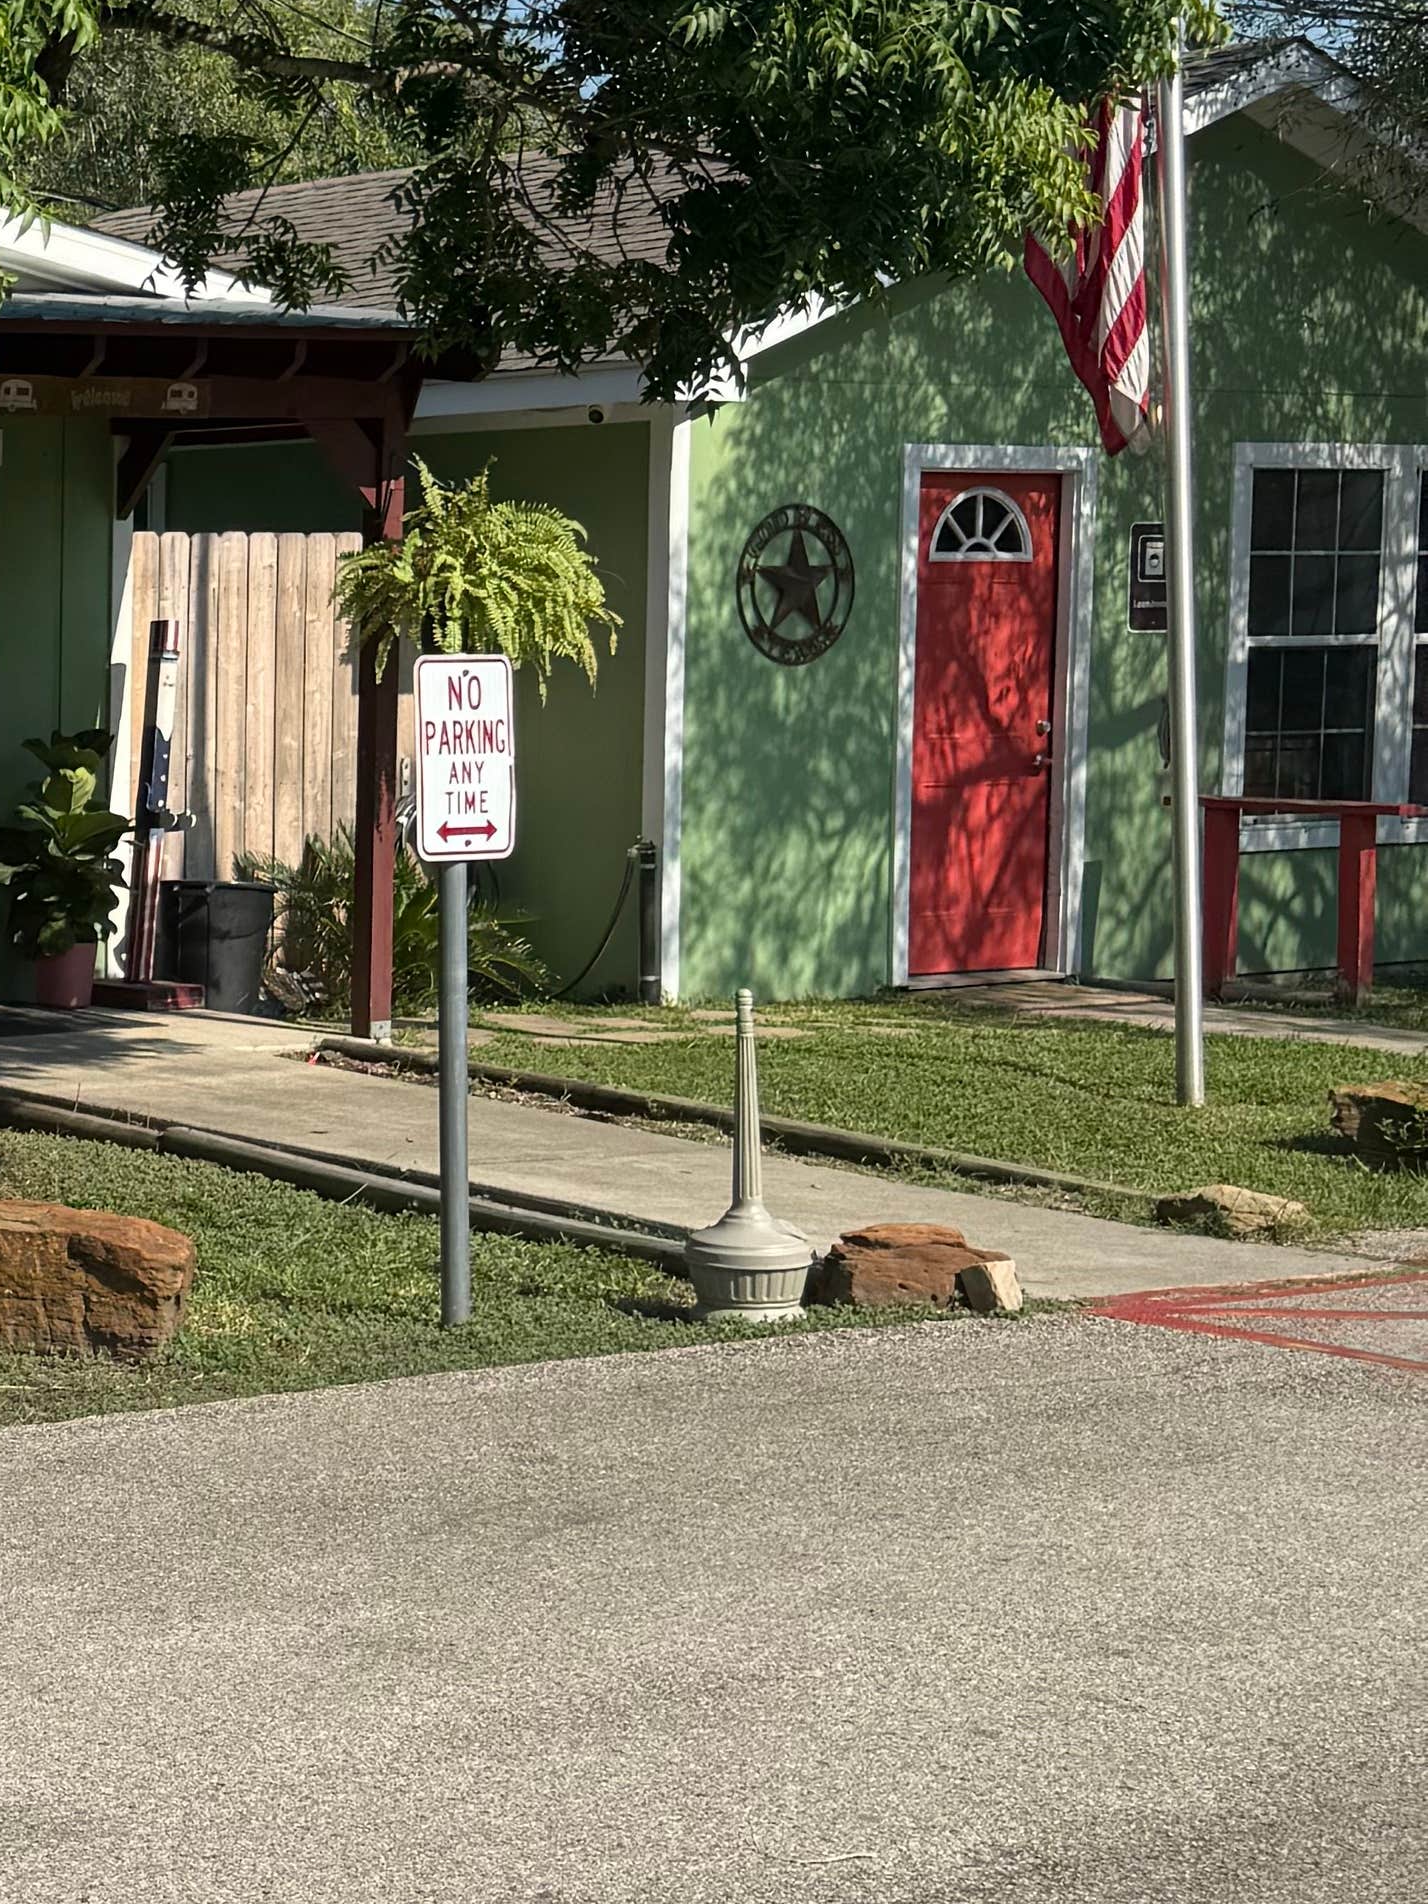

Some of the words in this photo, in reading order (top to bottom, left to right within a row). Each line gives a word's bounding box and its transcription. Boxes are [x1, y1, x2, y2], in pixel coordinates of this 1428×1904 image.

[447, 675, 482, 711] NO
[425, 719, 505, 756] PARKING
[448, 760, 485, 785] ANY
[445, 790, 489, 815] TIME
